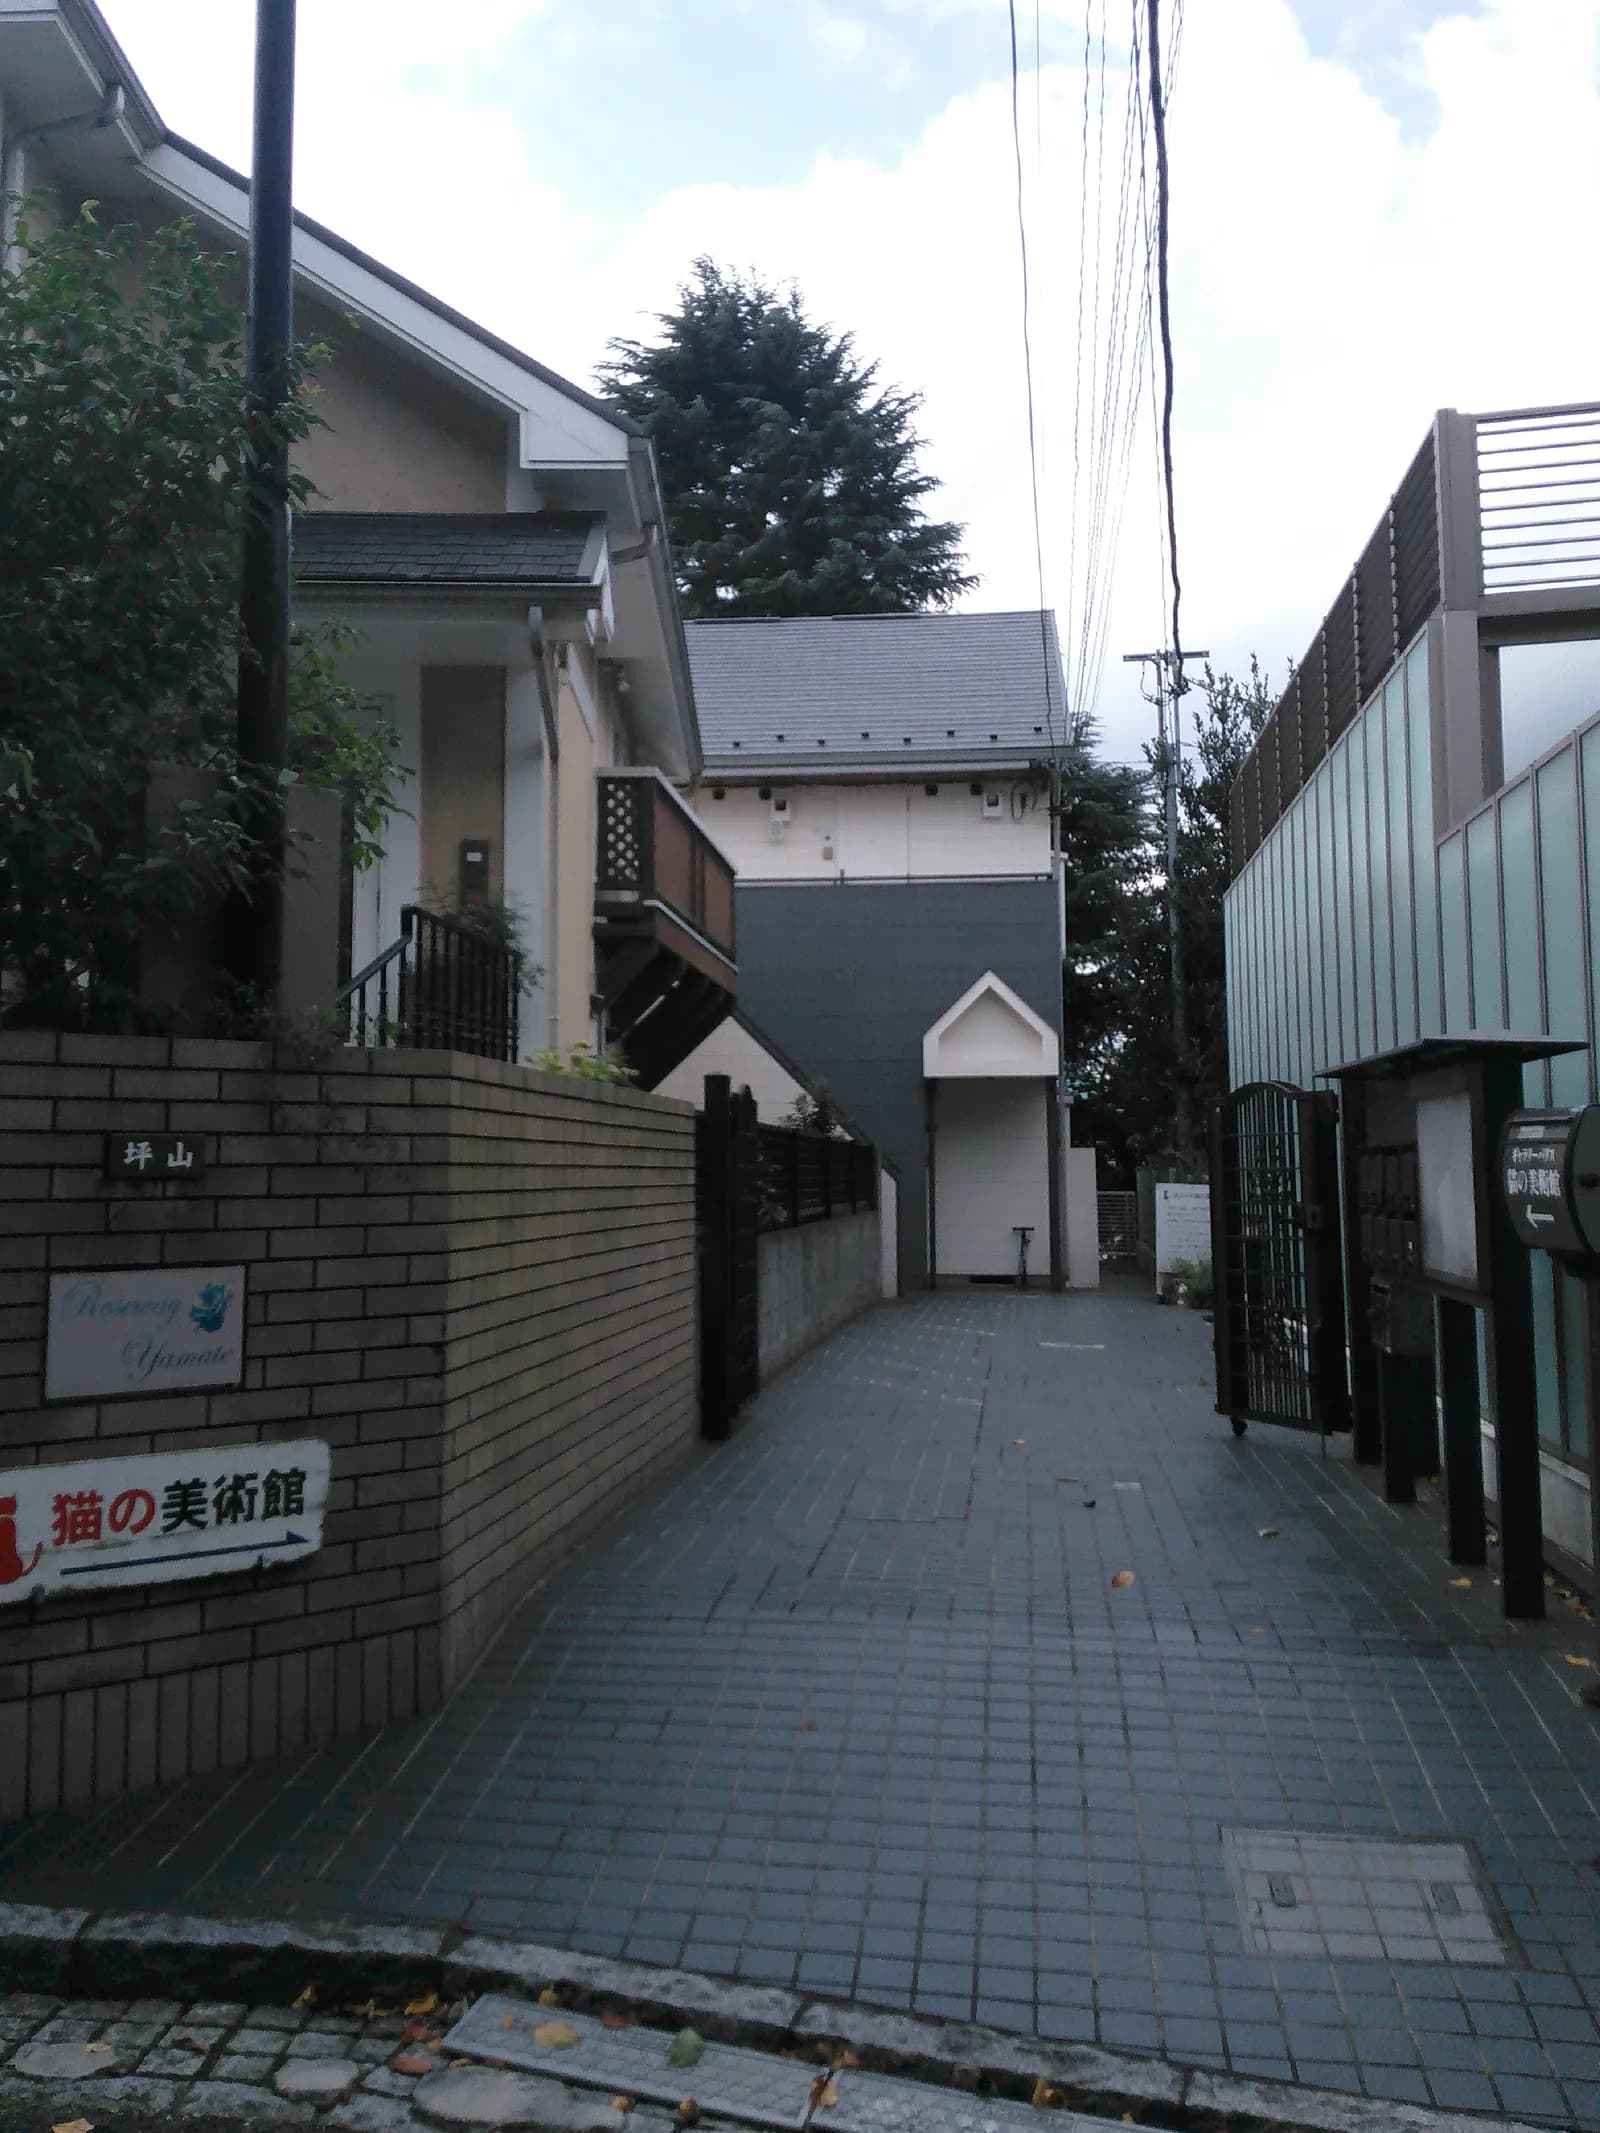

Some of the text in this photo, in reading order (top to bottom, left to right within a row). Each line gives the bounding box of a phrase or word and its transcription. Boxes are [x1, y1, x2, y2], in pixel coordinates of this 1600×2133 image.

[121, 1334, 234, 1382] Yamate
[52, 1466, 307, 1547] 猫の美術館
